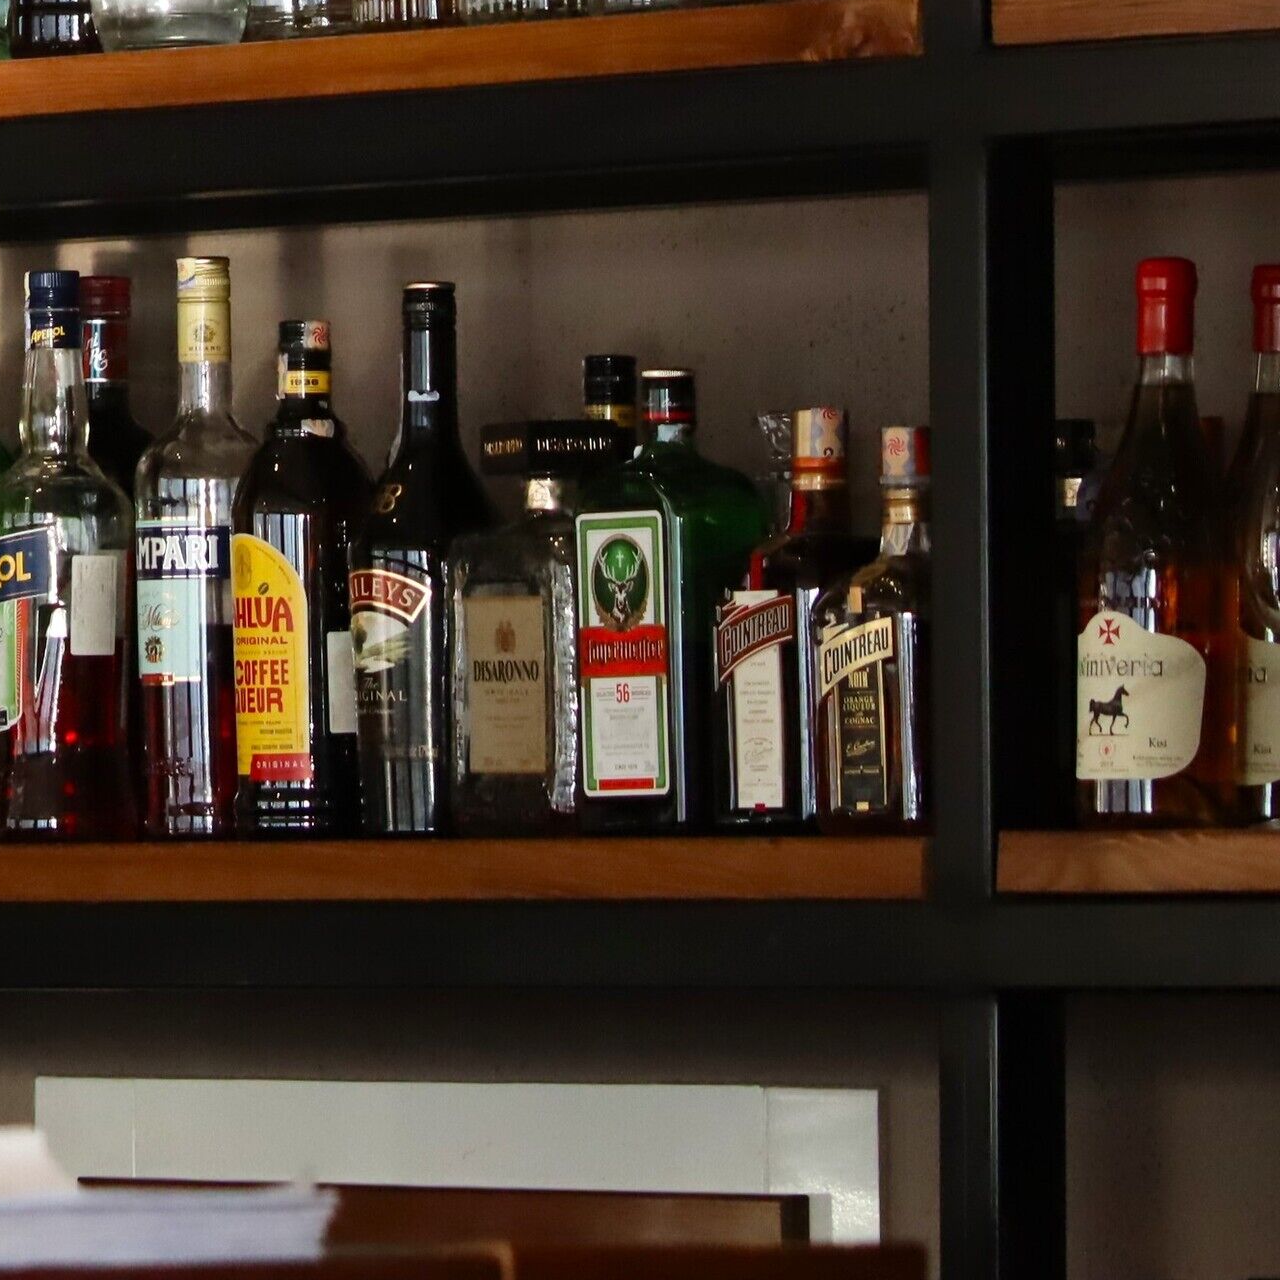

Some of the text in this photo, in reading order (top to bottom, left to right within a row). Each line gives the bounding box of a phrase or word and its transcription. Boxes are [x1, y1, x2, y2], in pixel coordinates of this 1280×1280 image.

[236, 636, 288, 646] ORIGINAL
[721, 604, 789, 668] COINTREAU
[823, 626, 890, 685] COINTREAU
[235, 659, 289, 686] COFFEE
[473, 659, 540, 684] DISARONNO
[847, 669, 869, 688] NOIR
[616, 683, 630, 703] 56
[256, 760, 305, 769] ORIGINAL
